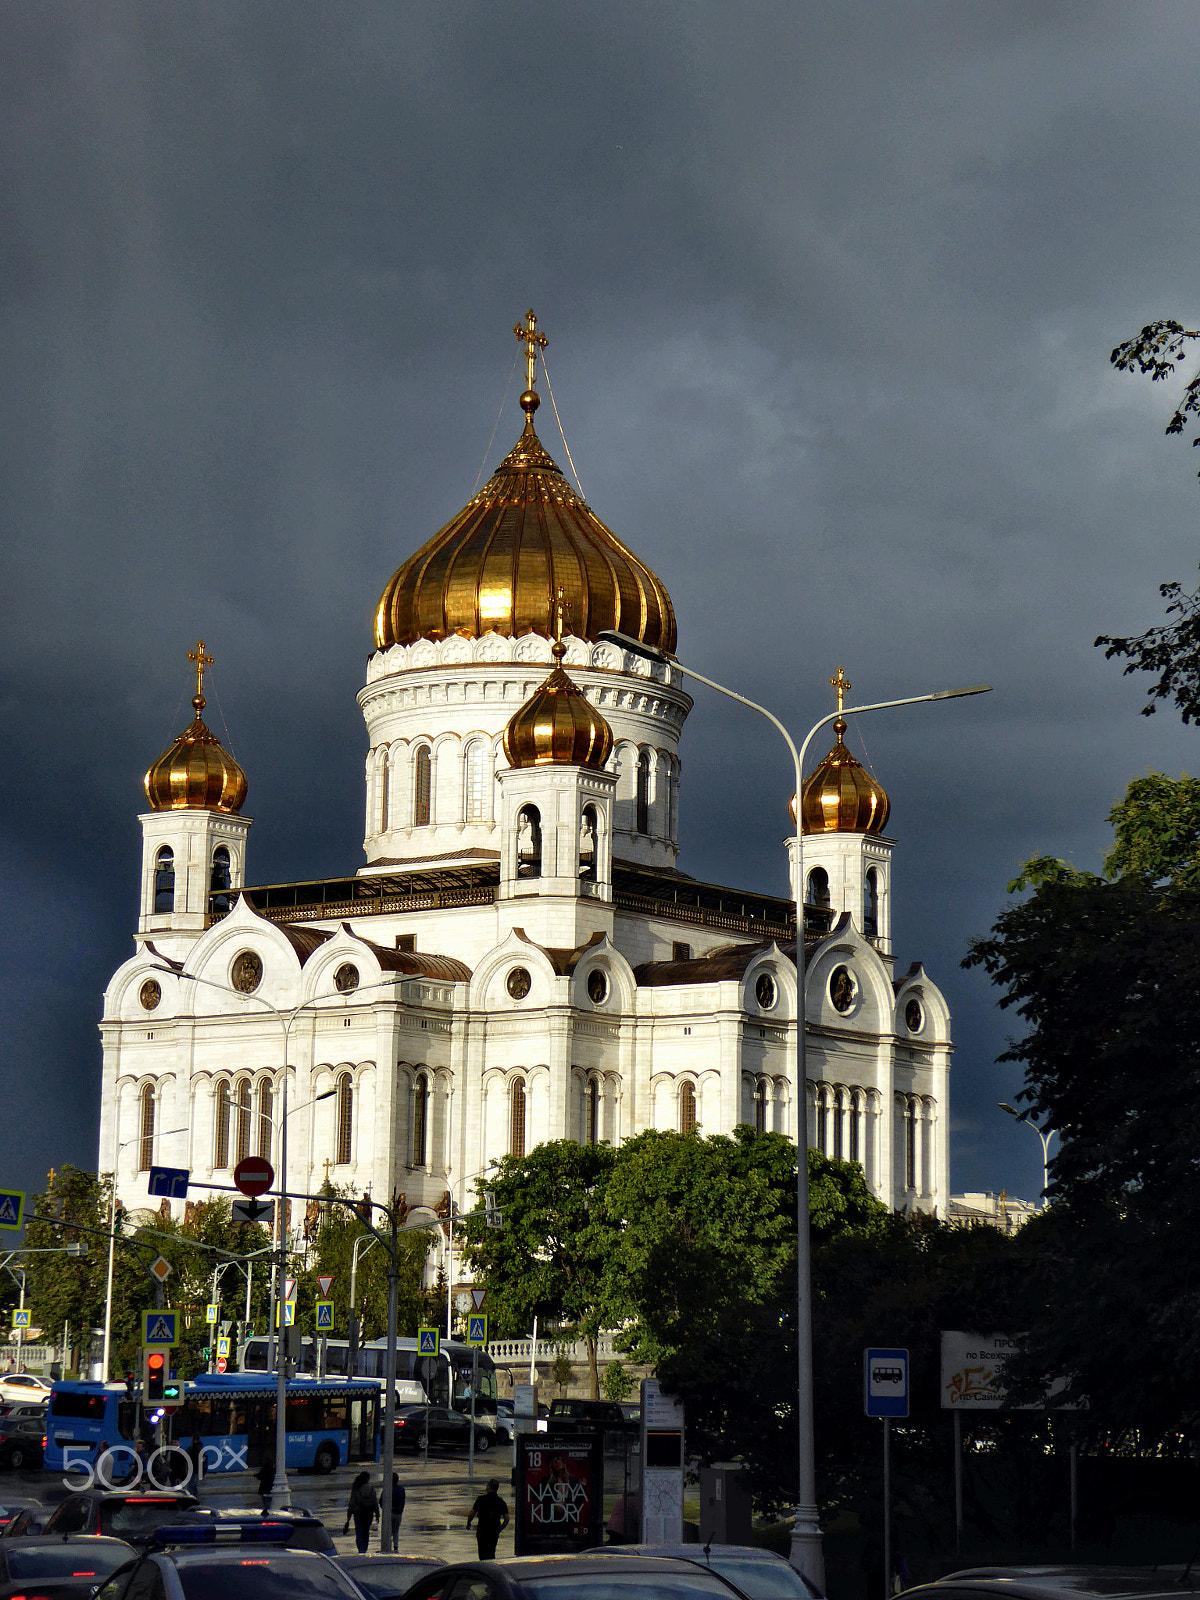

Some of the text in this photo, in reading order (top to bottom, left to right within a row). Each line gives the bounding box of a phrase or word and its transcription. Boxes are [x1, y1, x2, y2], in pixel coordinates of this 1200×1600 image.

[994, 1339, 1016, 1348] ПРО
[966, 1352, 977, 1360] по
[527, 1451, 542, 1468] 18
[527, 1482, 589, 1503] NASTYA
[530, 1503, 585, 1524] KUDRY
